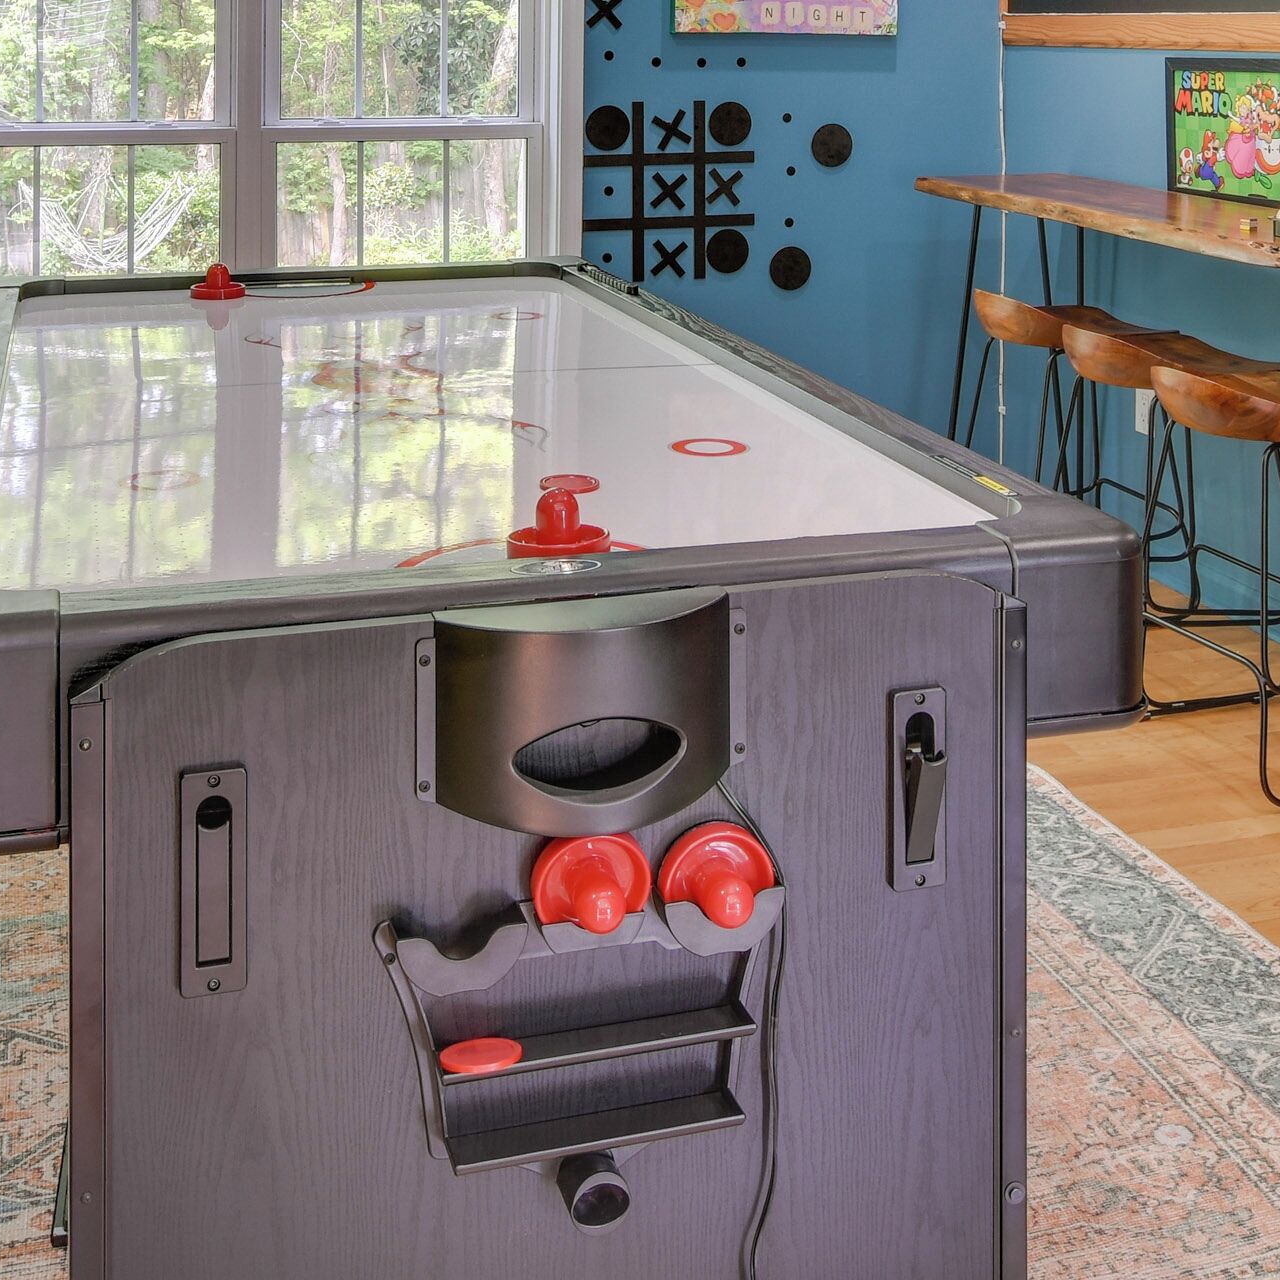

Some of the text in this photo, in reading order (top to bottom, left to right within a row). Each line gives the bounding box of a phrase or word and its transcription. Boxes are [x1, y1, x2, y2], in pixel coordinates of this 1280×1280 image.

[765, 7, 868, 22] NIGHT
[1181, 70, 1225, 91] SUPER
[1174, 87, 1233, 118] MARIO
